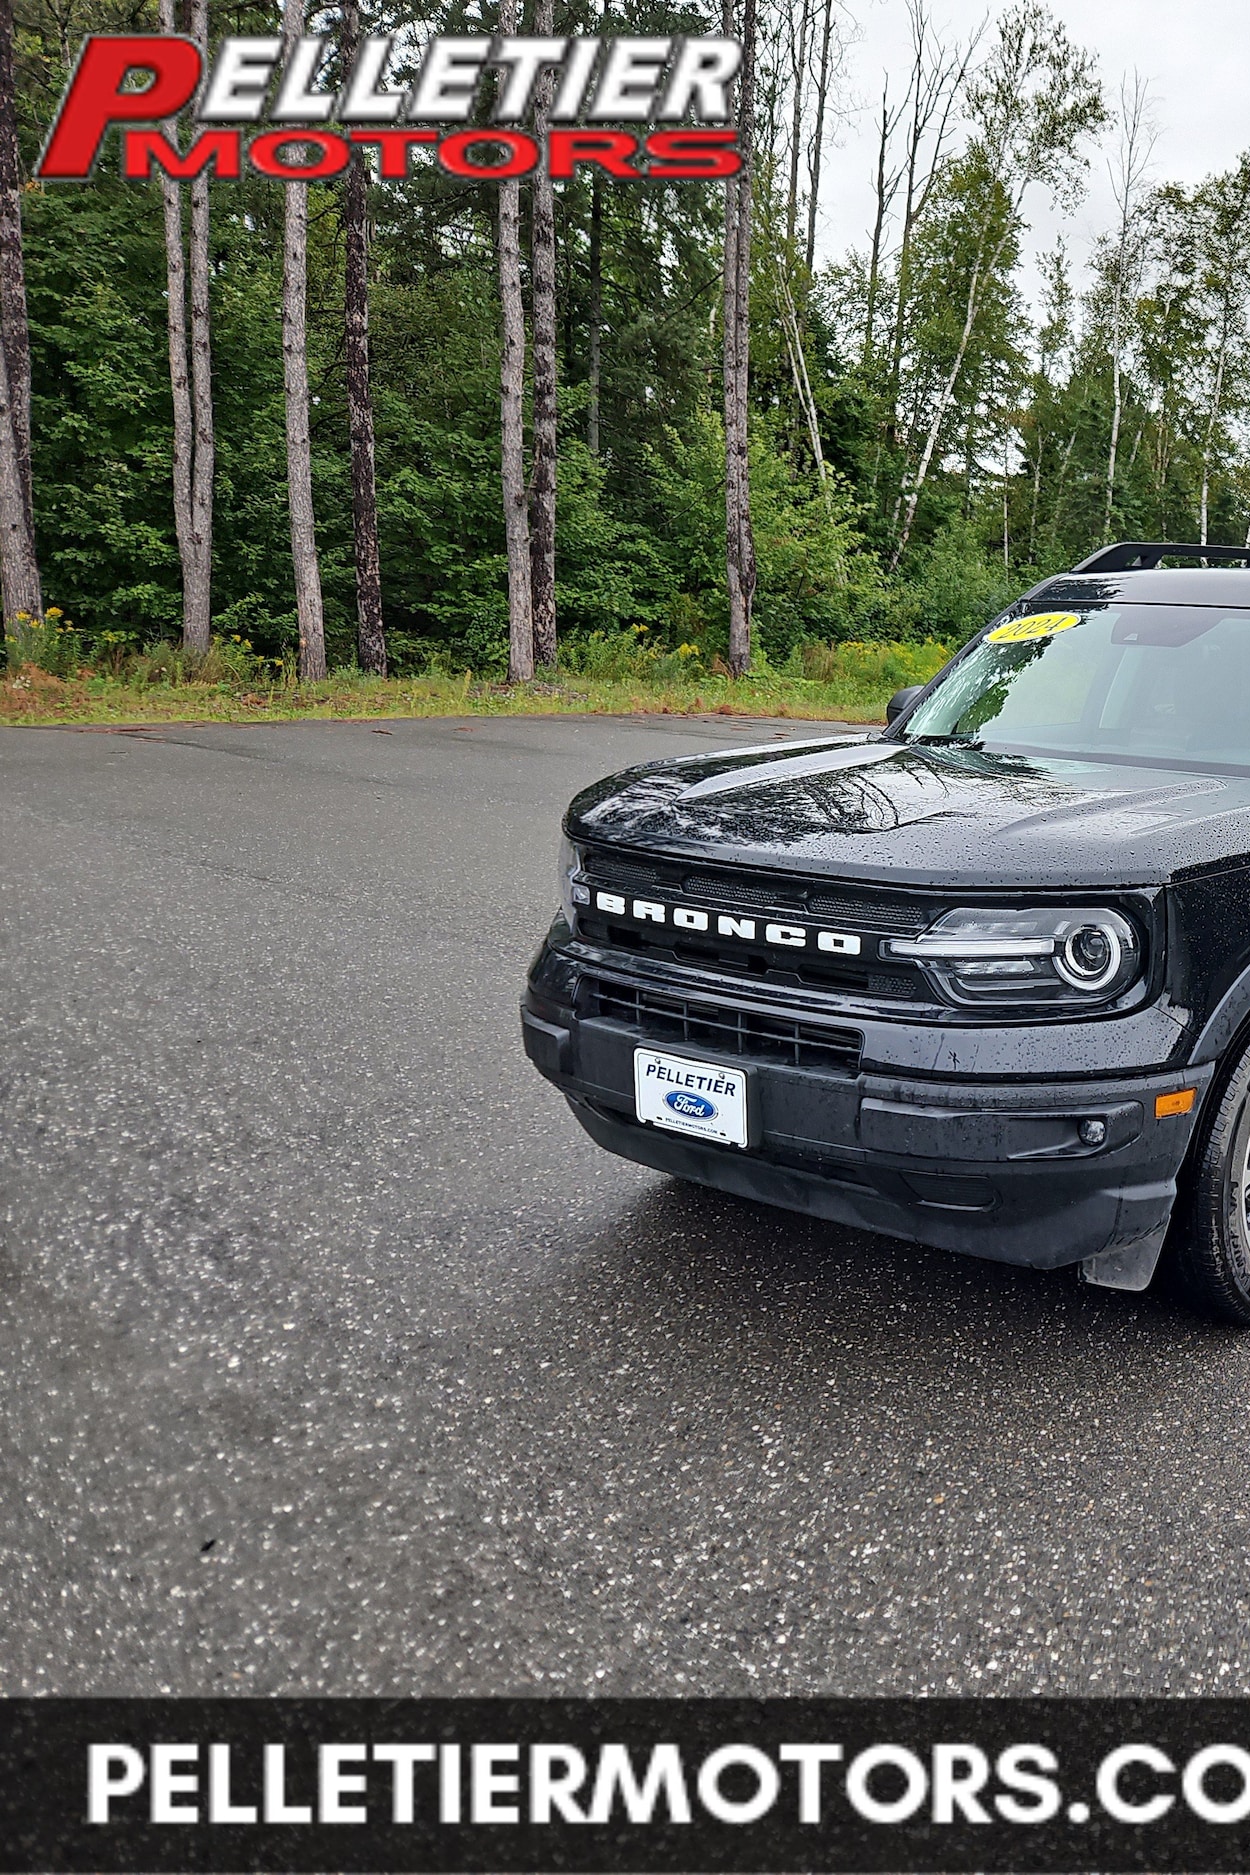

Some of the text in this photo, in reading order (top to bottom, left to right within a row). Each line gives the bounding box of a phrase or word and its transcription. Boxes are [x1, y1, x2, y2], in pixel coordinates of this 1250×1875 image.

[997, 615, 1069, 640] 2024
[596, 891, 862, 955] BRONCO
[645, 1063, 737, 1097] PELLETIER
[673, 1094, 706, 1117] Ford
